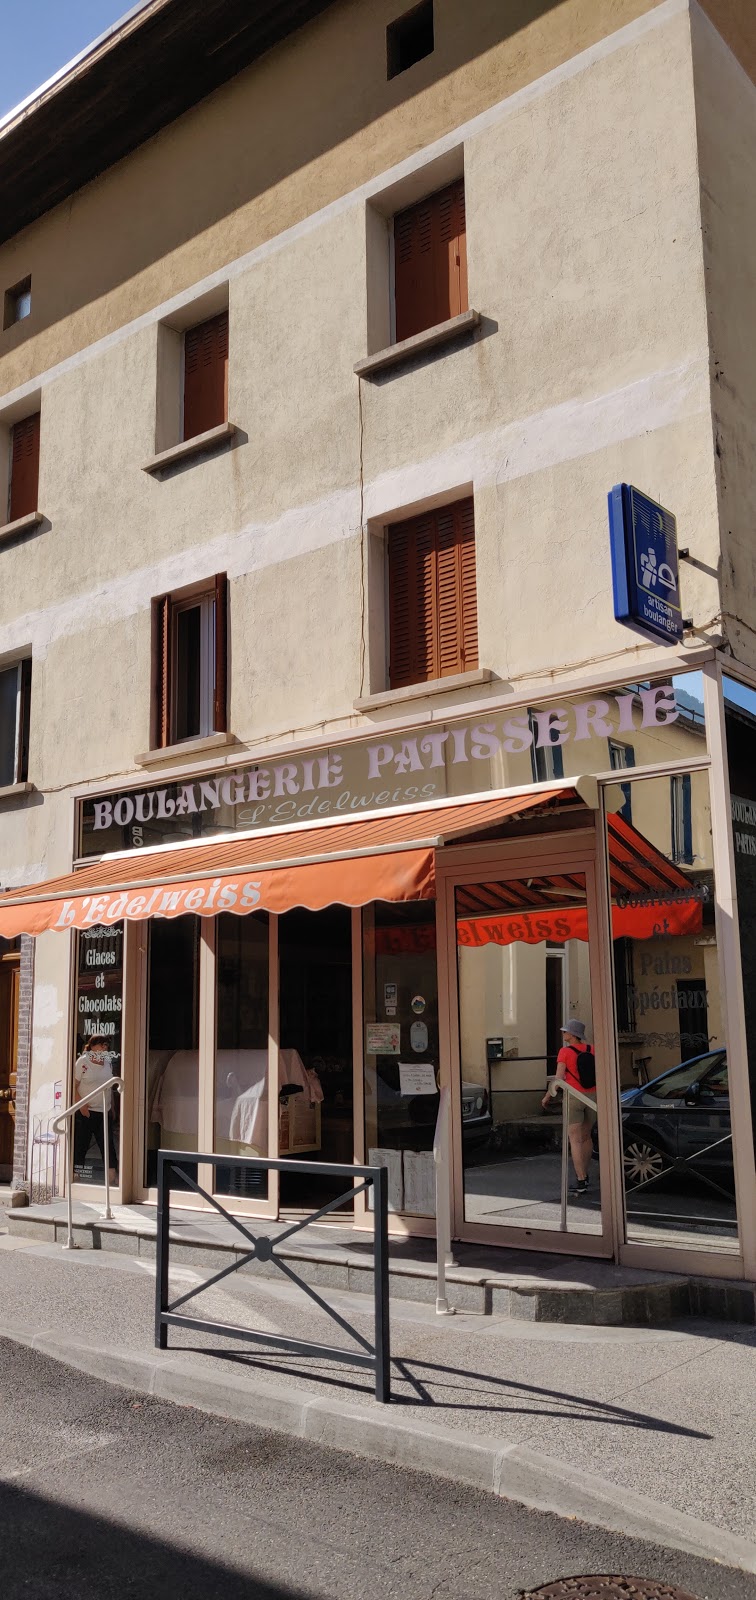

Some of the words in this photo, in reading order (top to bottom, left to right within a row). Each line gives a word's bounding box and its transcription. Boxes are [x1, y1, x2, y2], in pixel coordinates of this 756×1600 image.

[643, 604, 678, 632] boulanger
[647, 595, 673, 617] artisan
[92, 752, 344, 831] BOULANGERIE
[367, 684, 679, 780] PATISSERIE
[235, 783, 436, 828] L'Edelweiss
[54, 878, 262, 928] L'Edelweiss
[86, 949, 116, 966] Glaces
[640, 950, 693, 976] Pains
[95, 972, 105, 989] et
[78, 995, 122, 1013] Chocolats
[626, 984, 710, 1016] Spéciaux
[83, 1018, 116, 1036] Maison
